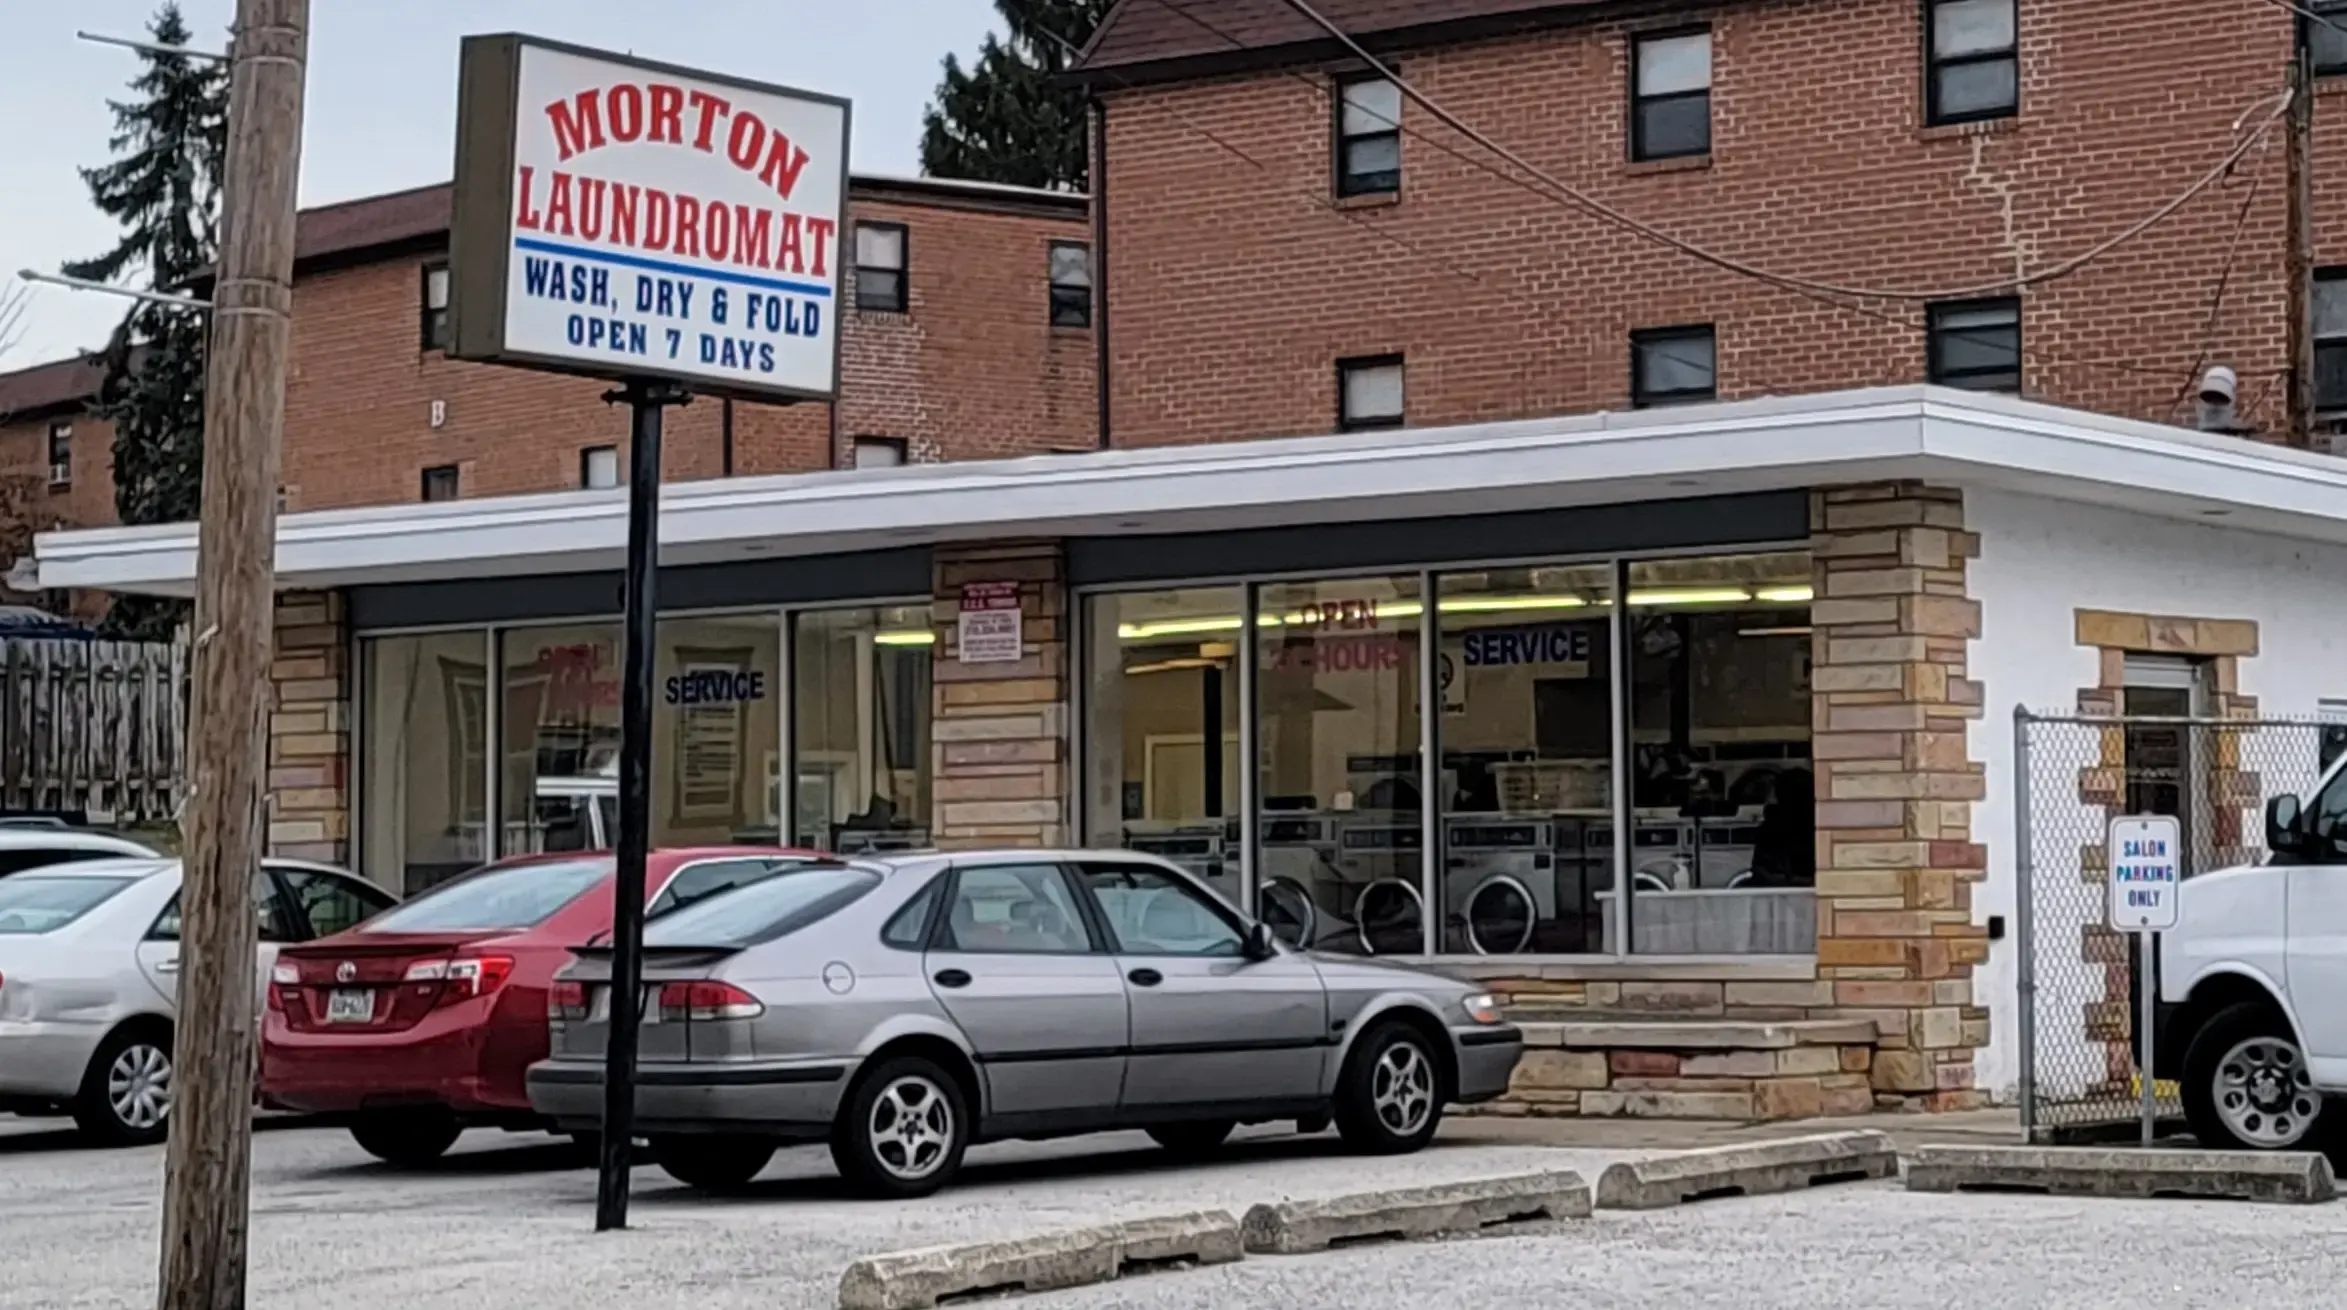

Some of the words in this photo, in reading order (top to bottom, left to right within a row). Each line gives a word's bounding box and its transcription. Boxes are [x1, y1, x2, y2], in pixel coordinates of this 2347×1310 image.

[544, 83, 810, 201] MORTON
[516, 165, 835, 278] LAUNDROMAT
[524, 256, 619, 314] WASH,
[636, 275, 694, 320] DRY
[711, 287, 728, 326] &
[747, 293, 821, 338] FOLD
[567, 314, 647, 356] OPEN
[665, 328, 682, 359] 7
[700, 332, 775, 373] DAYS
[1303, 598, 1379, 632] OPEN
[1463, 629, 1589, 666] SERVICE
[665, 671, 765, 705] SERVICE
[2123, 840, 2166, 857] SALON
[2116, 864, 2174, 882] PARKING
[2127, 889, 2161, 907] ONLY
